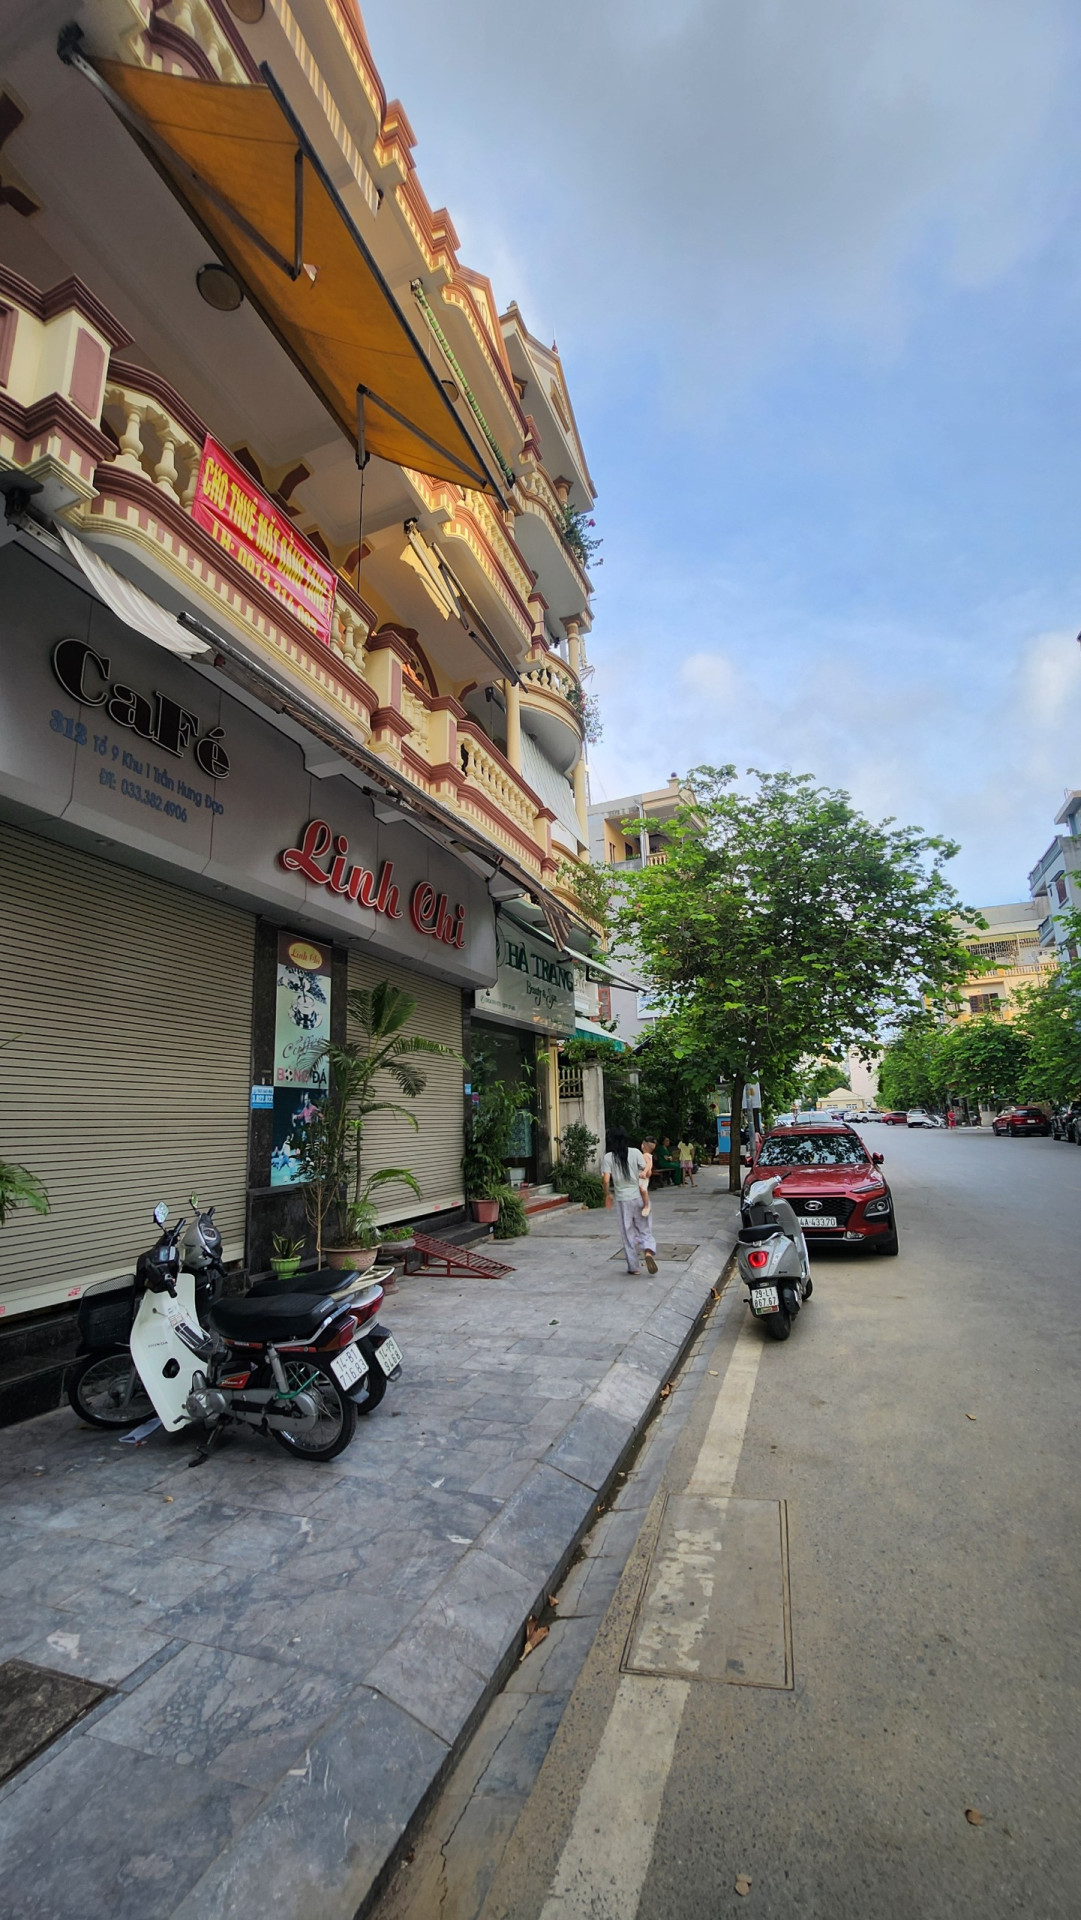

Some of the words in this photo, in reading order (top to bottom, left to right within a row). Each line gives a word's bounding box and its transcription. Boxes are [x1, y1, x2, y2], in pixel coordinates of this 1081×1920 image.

[203, 457, 229, 511] CHO
[229, 482, 257, 541] THUÊ
[256, 513, 280, 565] MẶT
[49, 709, 87, 746] 312
[112, 744, 120, 761] 9
[122, 750, 143, 775] Khu
[279, 819, 403, 919] Linh
[410, 881, 467, 949] Chi
[505, 941, 530, 974] HÀ
[530, 953, 574, 992] TRANG
[312, 1068, 327, 1085] ĐÁ
